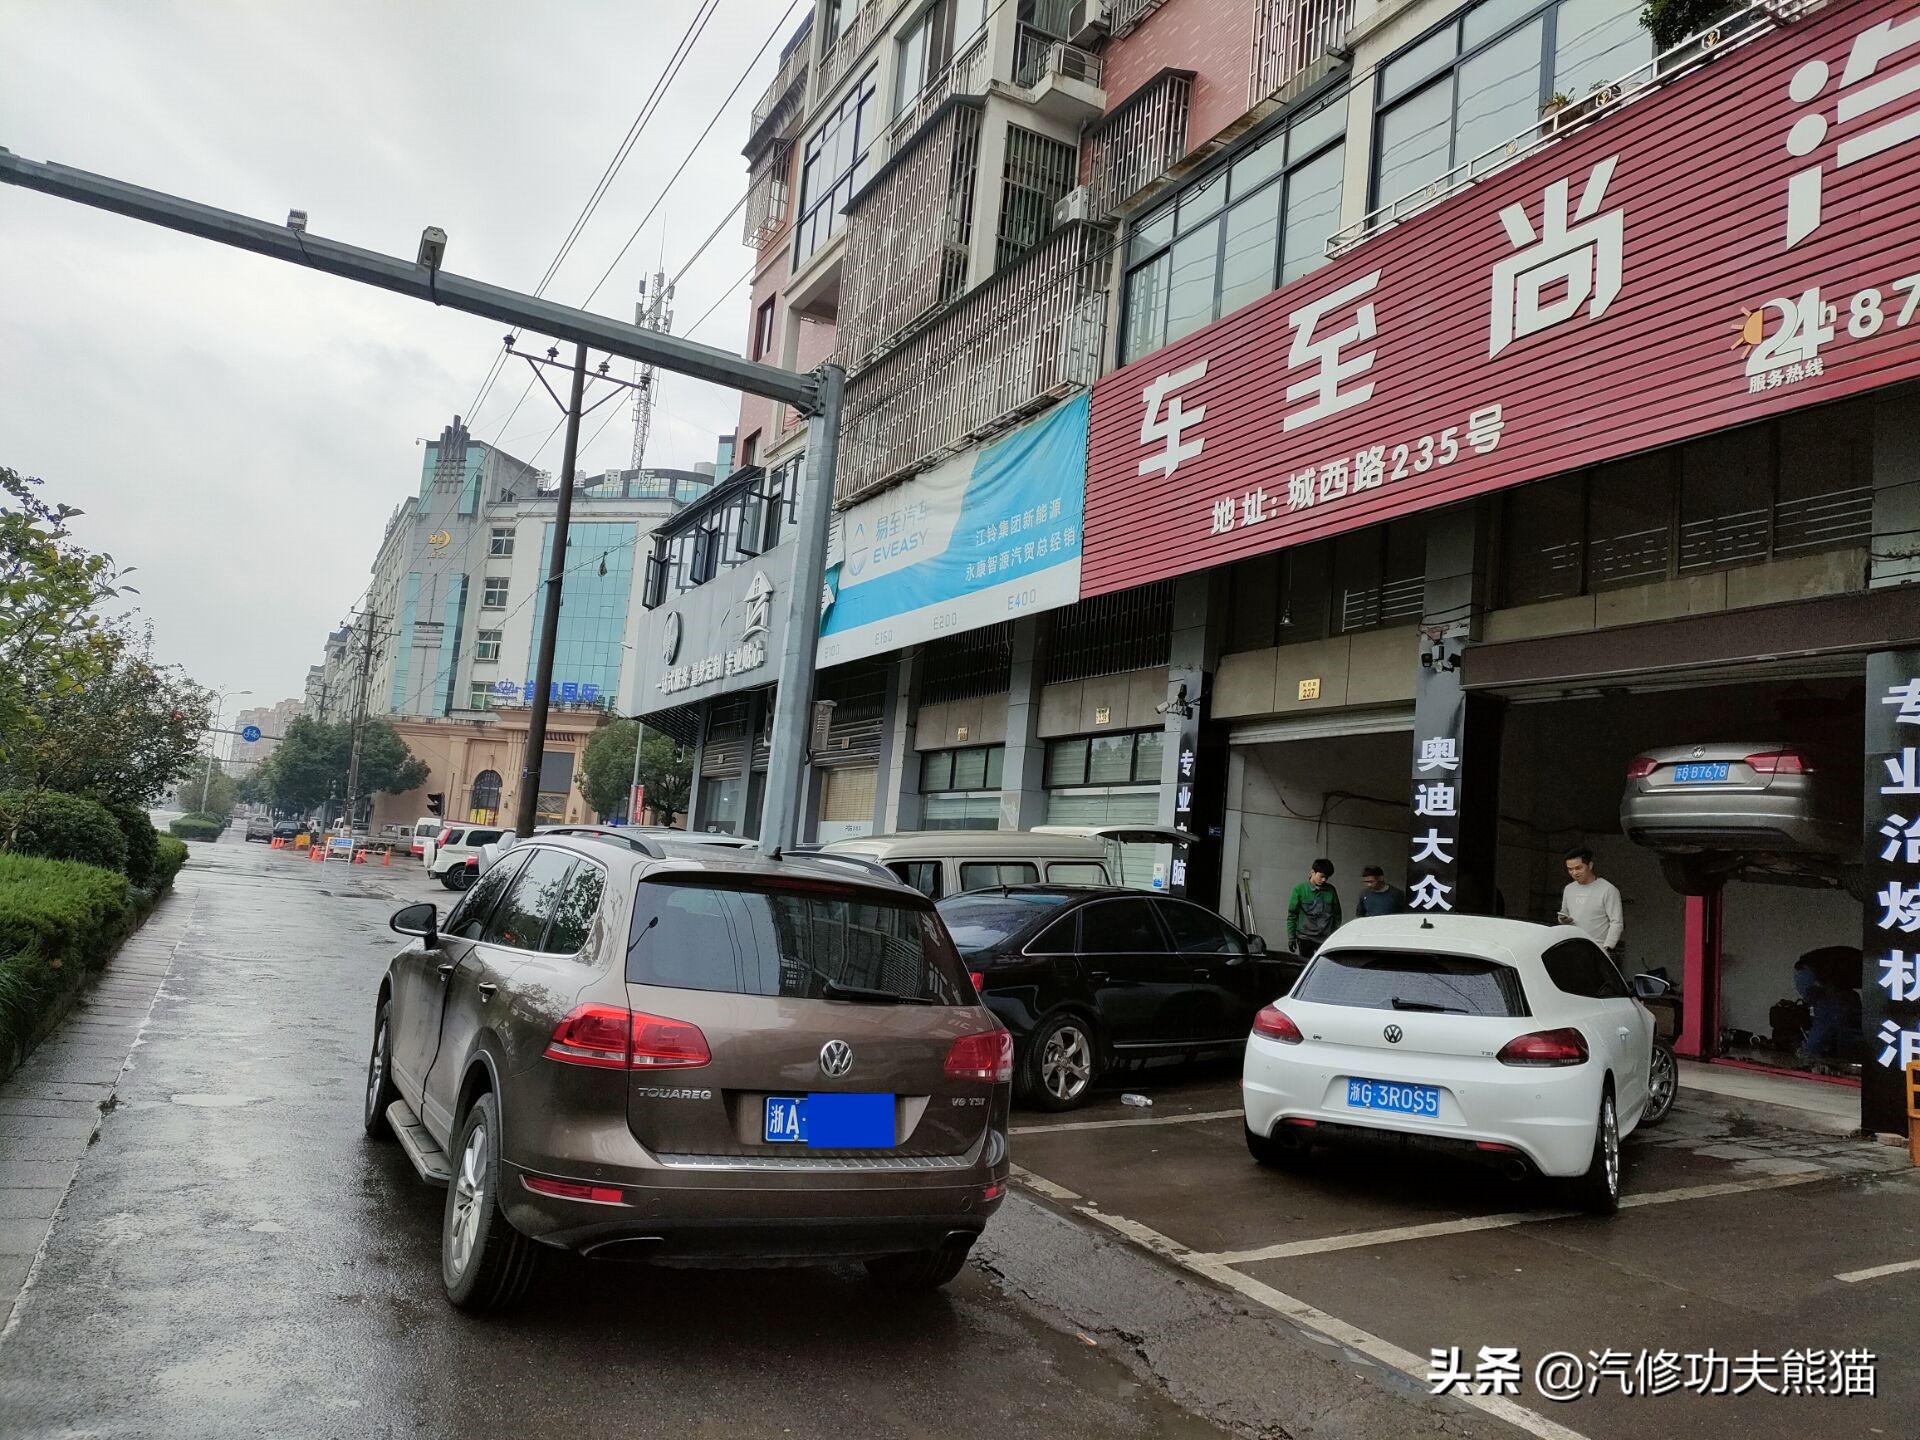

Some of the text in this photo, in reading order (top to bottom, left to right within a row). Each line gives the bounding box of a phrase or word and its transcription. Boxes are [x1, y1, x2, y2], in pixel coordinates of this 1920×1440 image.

[1745, 274, 1920, 376] 24h 87
[1749, 358, 1824, 394] 服务热线
[976, 497, 1062, 548] 江铃集团新能源
[873, 528, 928, 564] EVEASY
[932, 611, 958, 631] E200
[1007, 588, 1037, 612] E400
[1409, 736, 1460, 911] 奥迪大众
[637, 1087, 712, 1101] TOUAREG
[951, 1096, 985, 1107] V6 TSI
